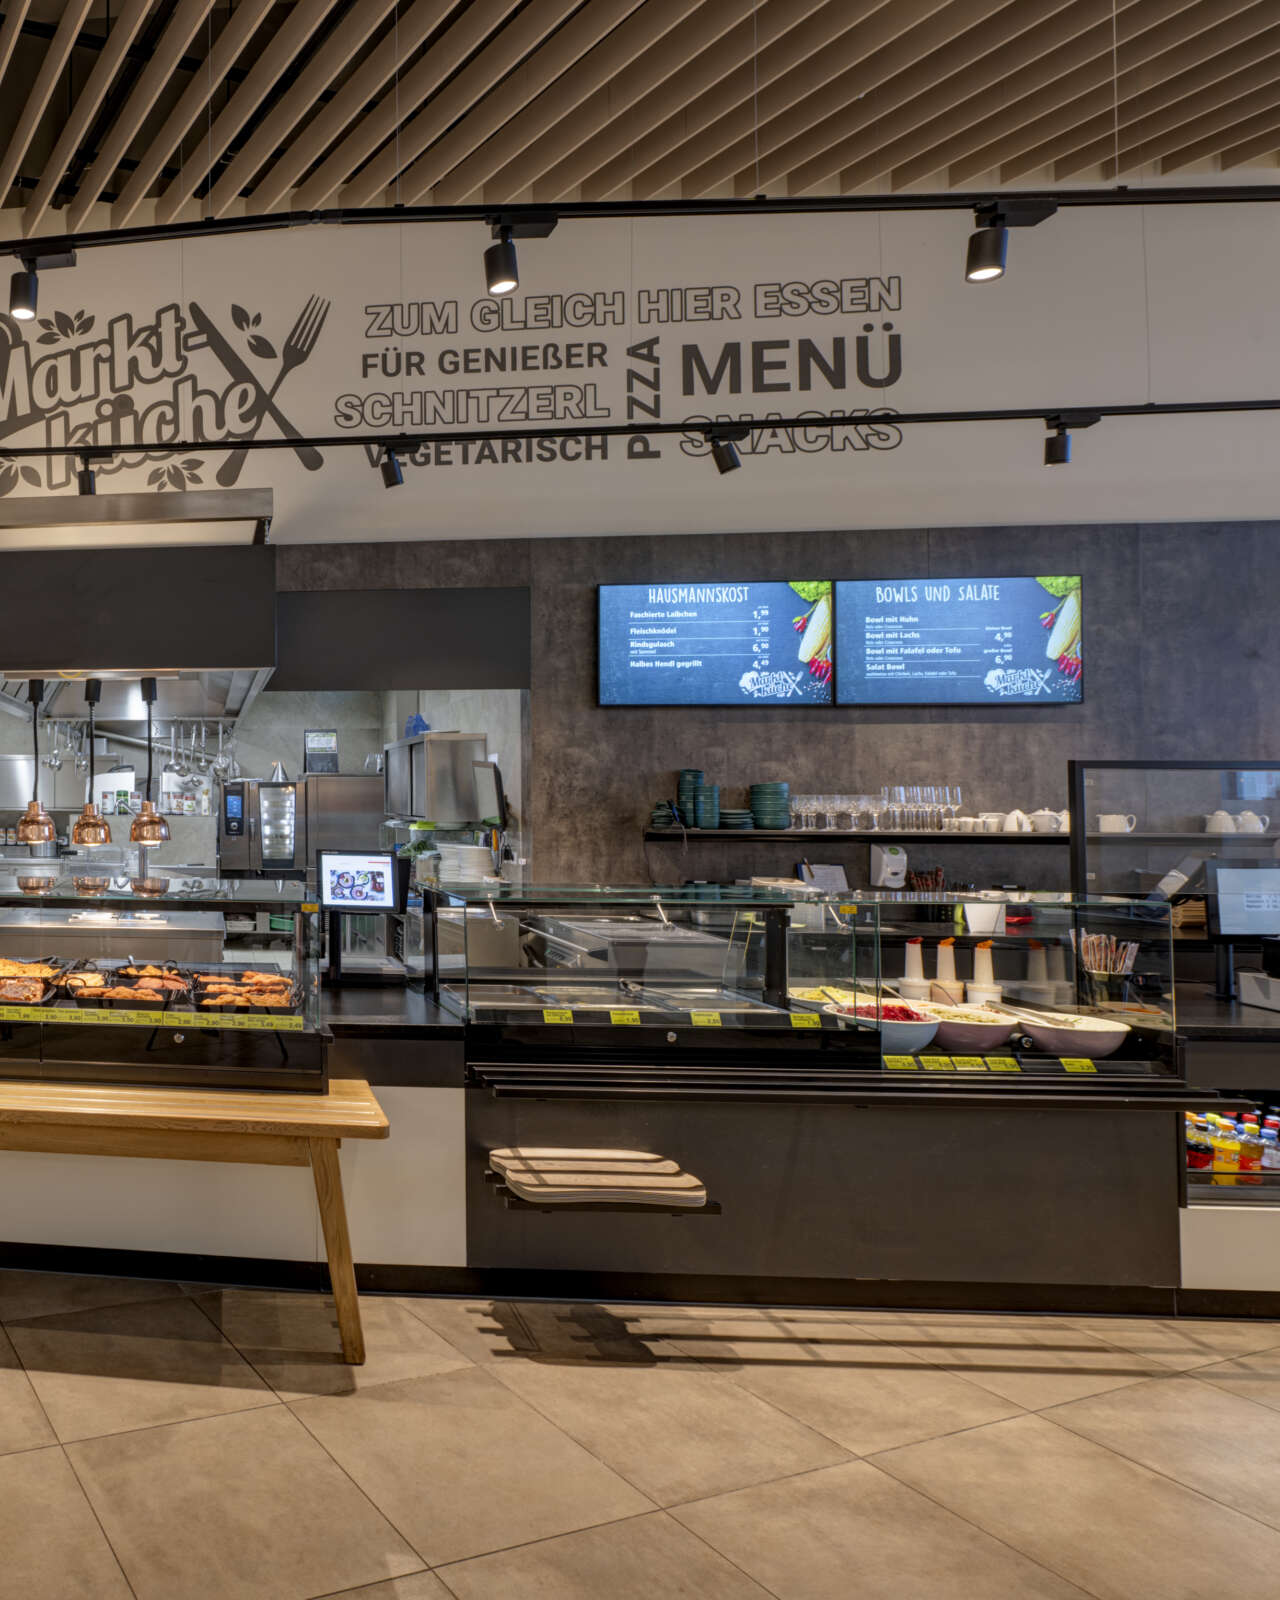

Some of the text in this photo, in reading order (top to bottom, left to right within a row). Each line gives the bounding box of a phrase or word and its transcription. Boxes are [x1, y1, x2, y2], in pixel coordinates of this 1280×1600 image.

[365, 276, 902, 338] ZUM GLEICH HIER ESSEN
[361, 341, 609, 378] FÜR GENIEßER
[682, 322, 902, 396] MENÜ
[334, 384, 610, 428] SCHNITZERL
[627, 336, 661, 460] PZZA
[648, 586, 750, 604] HAUSMANNSKOST
[876, 584, 1000, 604] BOWLS UND SALATE
